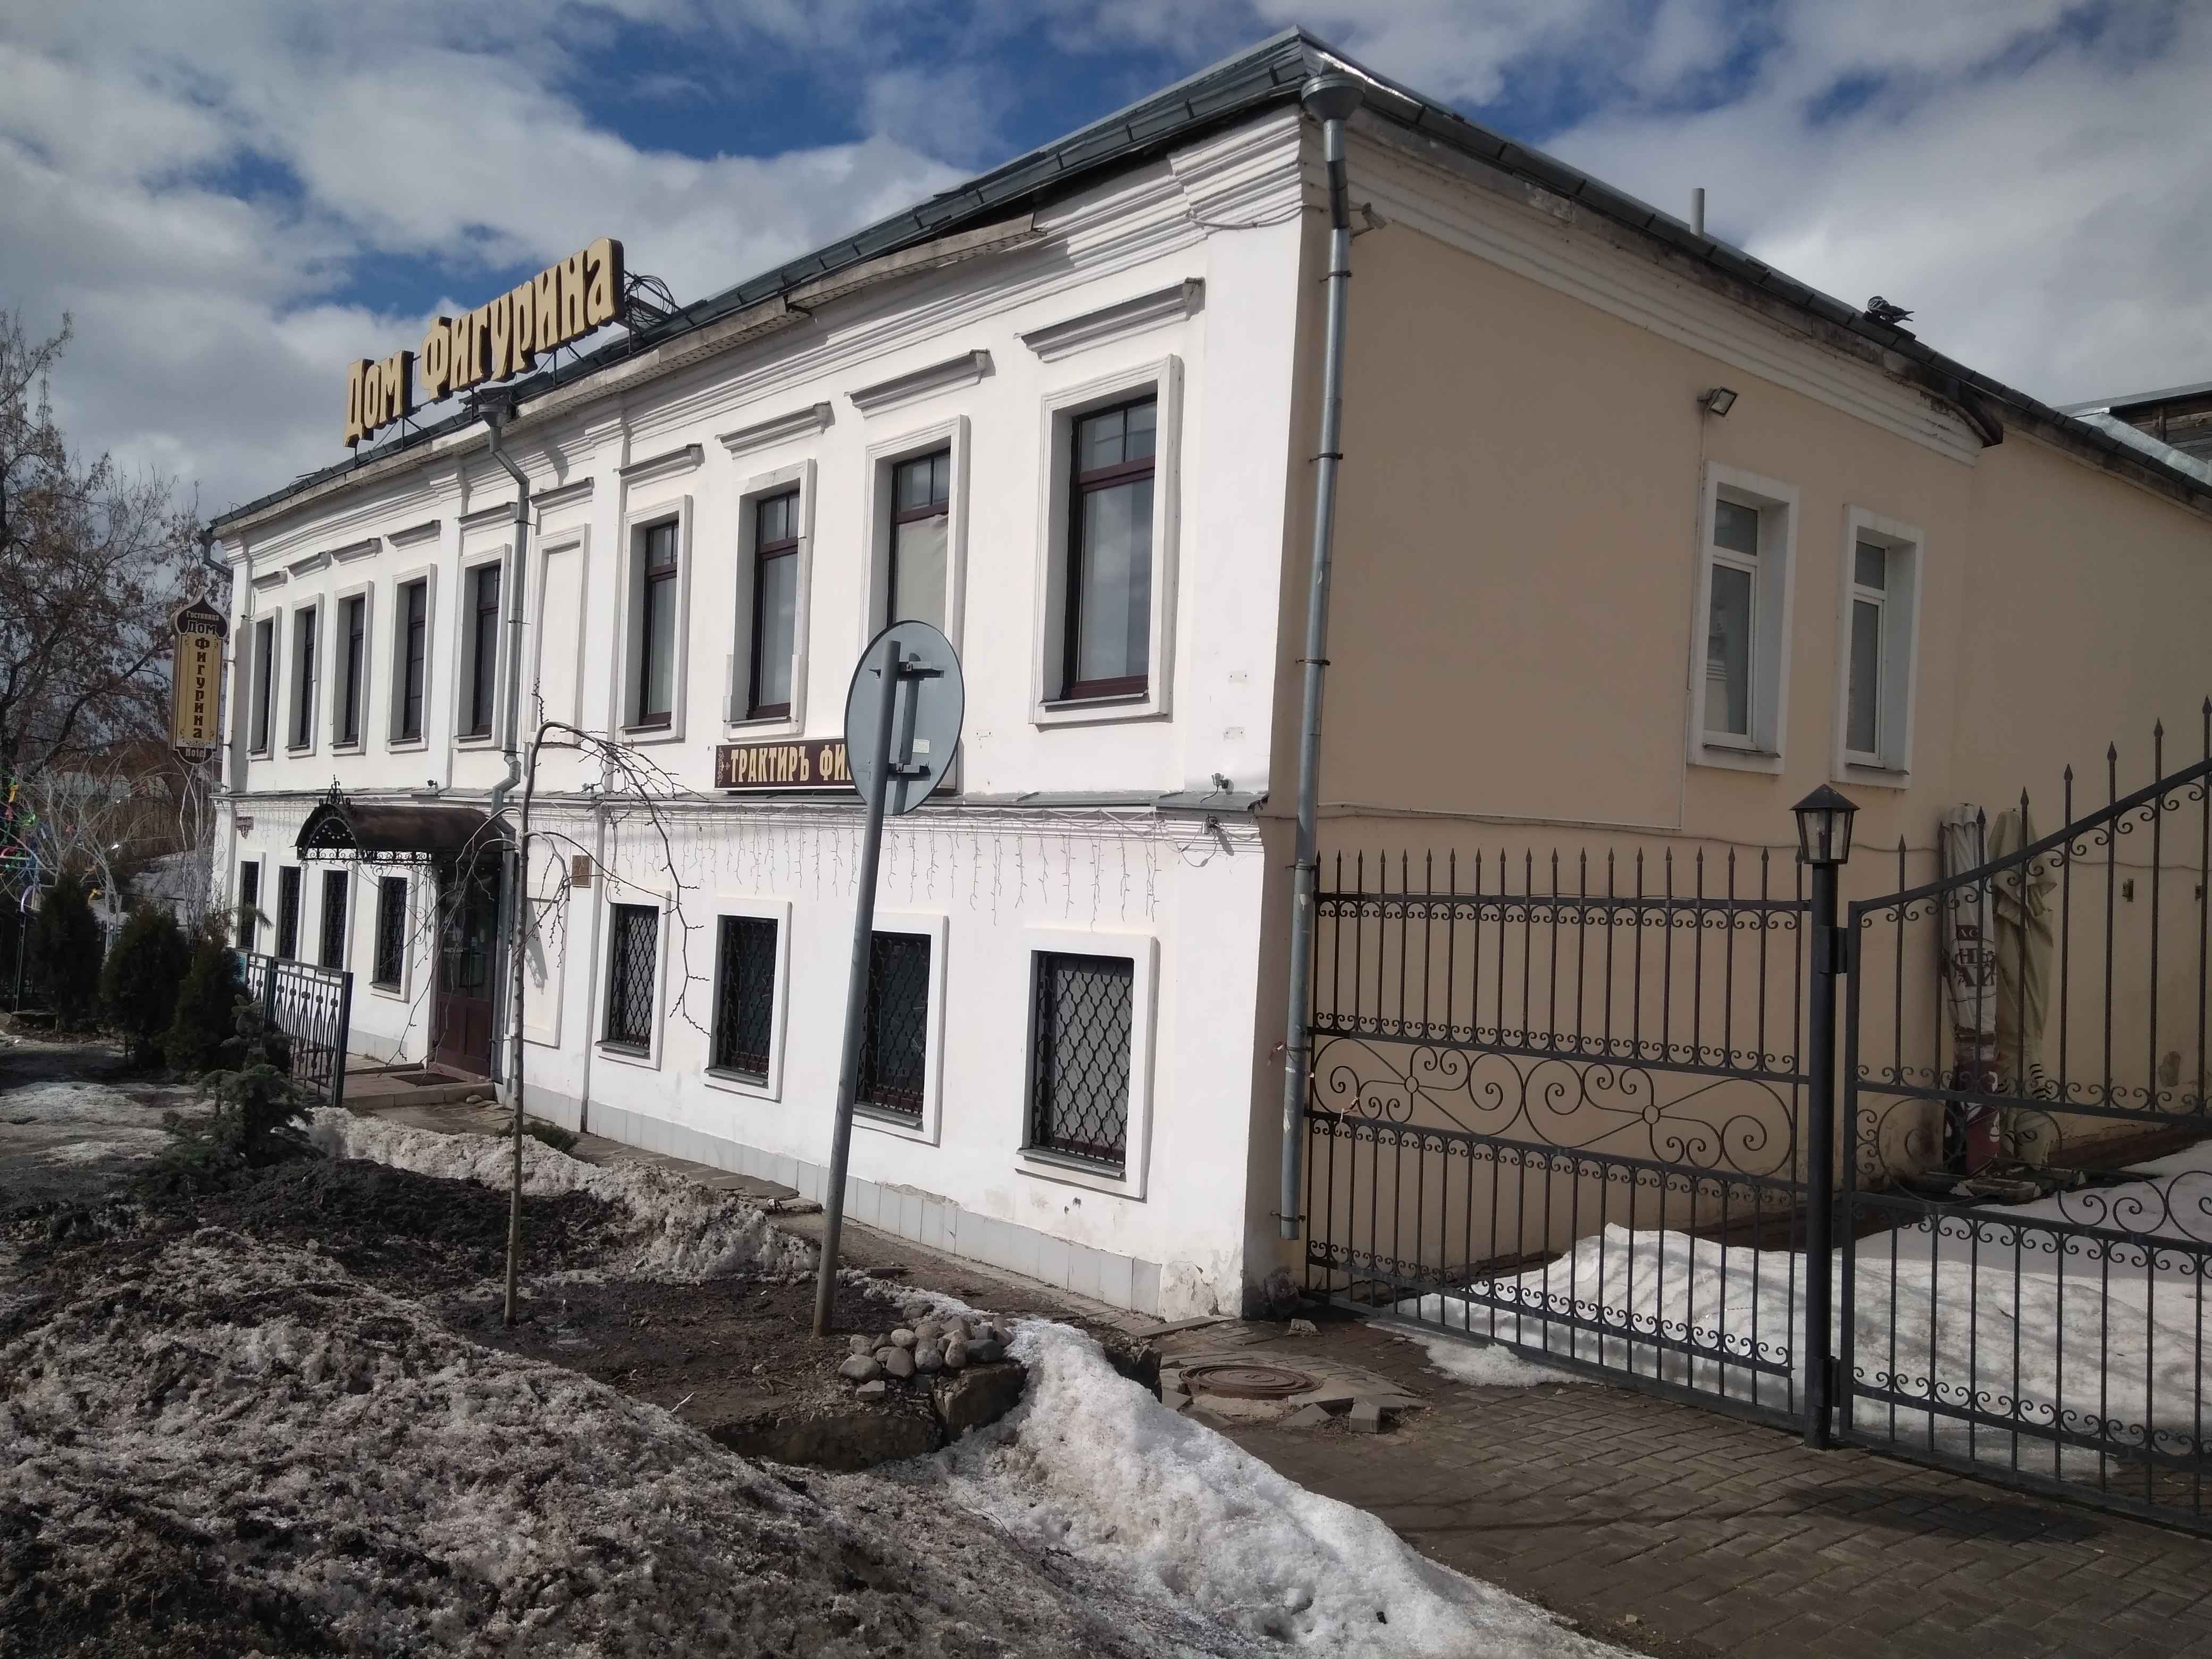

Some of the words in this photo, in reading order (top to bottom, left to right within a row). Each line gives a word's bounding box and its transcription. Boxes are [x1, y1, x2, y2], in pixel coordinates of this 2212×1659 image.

[186, 610, 219, 621] Гостиница
[731, 746, 809, 782] ТРАКТИРЪ
[819, 744, 852, 781] ФИ
